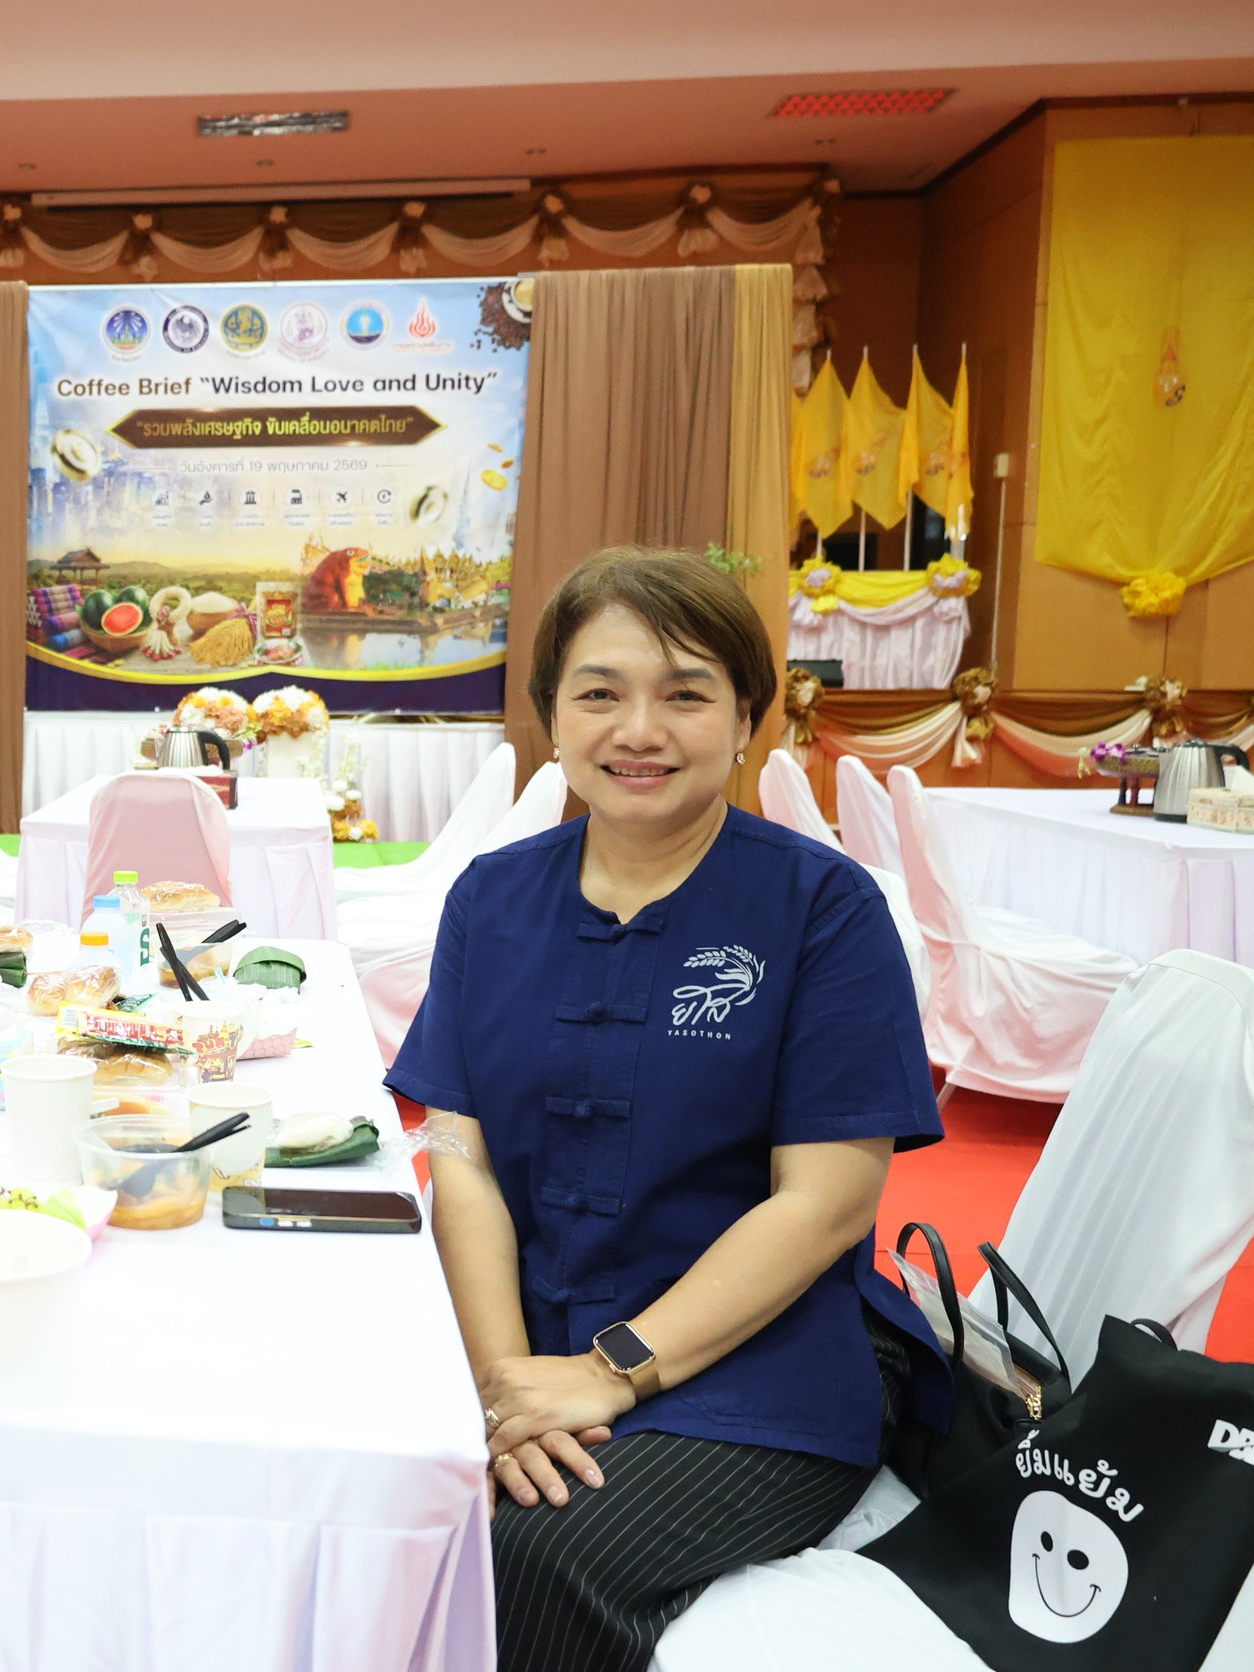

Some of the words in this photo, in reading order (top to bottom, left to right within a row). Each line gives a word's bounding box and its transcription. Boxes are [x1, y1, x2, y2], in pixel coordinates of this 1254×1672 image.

[57, 378, 130, 396] Coffee
[138, 377, 191, 395] Brief
[311, 376, 364, 393] Love
[373, 374, 416, 392] and
[180, 456, 244, 473] วันอังคารที่
[249, 460, 263, 472] 19
[267, 461, 329, 474] พฤษภาคม
[333, 459, 368, 472] 2569
[667, 1029, 732, 1040] YASOTHON
[1015, 1429, 1144, 1522] ยิ้มแย้ม
